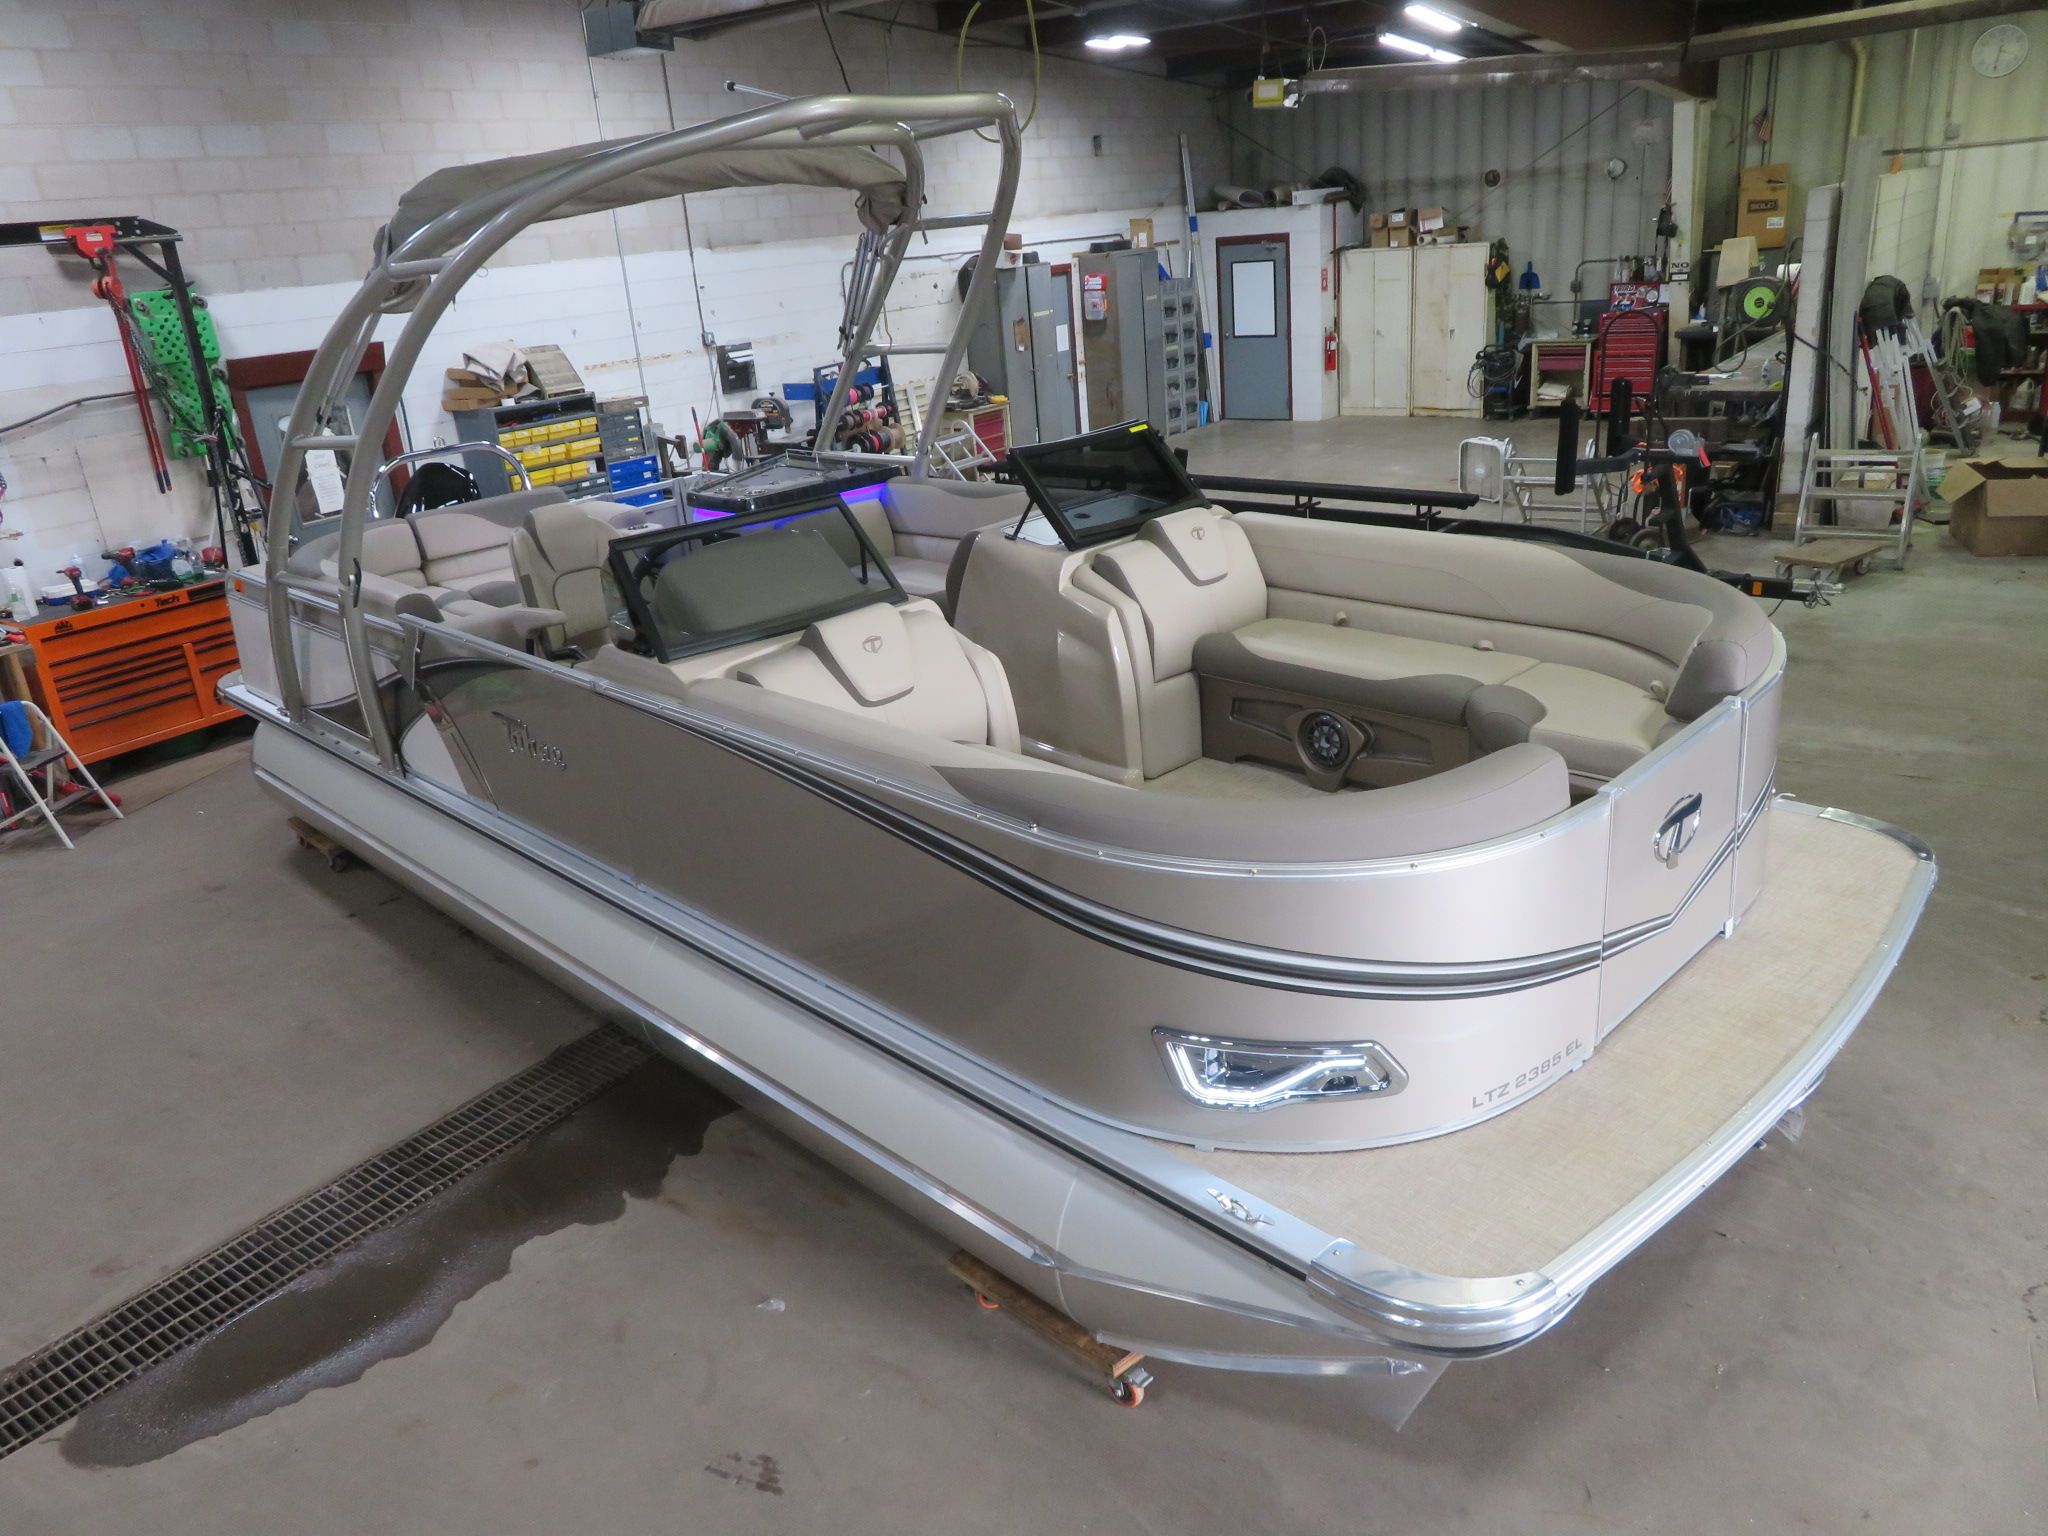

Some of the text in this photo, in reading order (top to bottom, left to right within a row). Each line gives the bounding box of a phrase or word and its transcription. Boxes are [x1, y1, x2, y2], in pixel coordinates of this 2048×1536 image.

[1671, 261, 1690, 269] NO
[1472, 1038, 1583, 1109] LTZ 2385 EL
